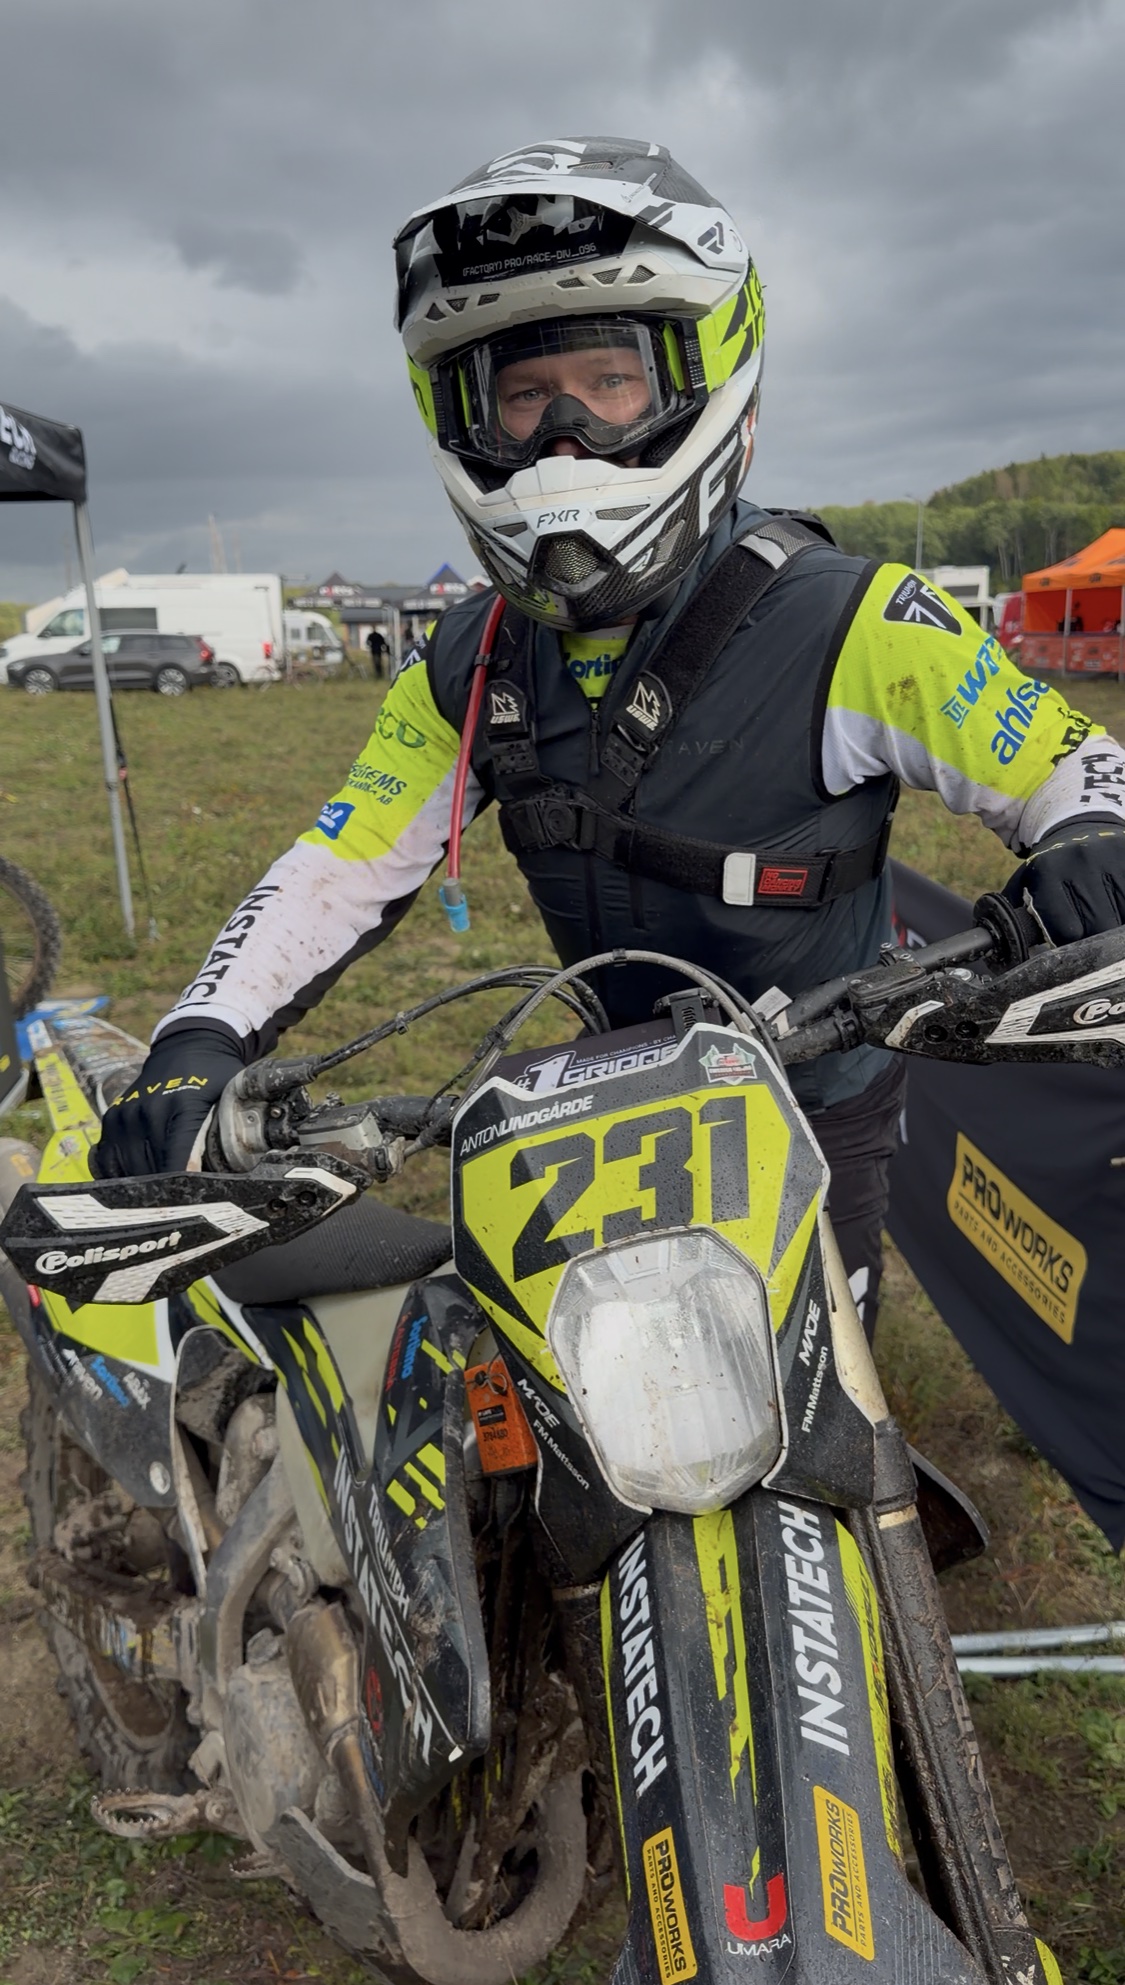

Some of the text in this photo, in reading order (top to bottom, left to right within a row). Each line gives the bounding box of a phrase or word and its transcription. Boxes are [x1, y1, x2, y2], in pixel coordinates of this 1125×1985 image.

[536, 509, 580, 529] FXR
[490, 713, 521, 725] USWE
[625, 704, 658, 732] USWE
[576, 1055, 595, 1064] MADE
[595, 1052, 609, 1060] FOR
[609, 1041, 648, 1056] CHAMPIONS
[510, 1095, 750, 1281] 231
[35, 1231, 182, 1275] Polisport
[962, 1153, 1074, 1294] PROWORKS
[953, 1200, 1065, 1324] PARTS AND ACCESSORIES
[799, 1298, 821, 1367] MADE
[806, 1345, 829, 1410] Mattsson
[533, 1419, 590, 1491] FM Mattsson
[778, 1500, 850, 1756] INSTATECH
[617, 1530, 668, 1797] INSTATECH
[825, 1799, 853, 1937] PROWORKS
[847, 1812, 860, 1882] ACCESSORIES
[647, 1848, 655, 1879] PARTS
[655, 1907, 670, 1979] ACCESSORIES
[655, 1839, 687, 1972] PROWORKS
[857, 1911, 867, 1947] PARTS
[725, 1933, 792, 1957] UMARA
